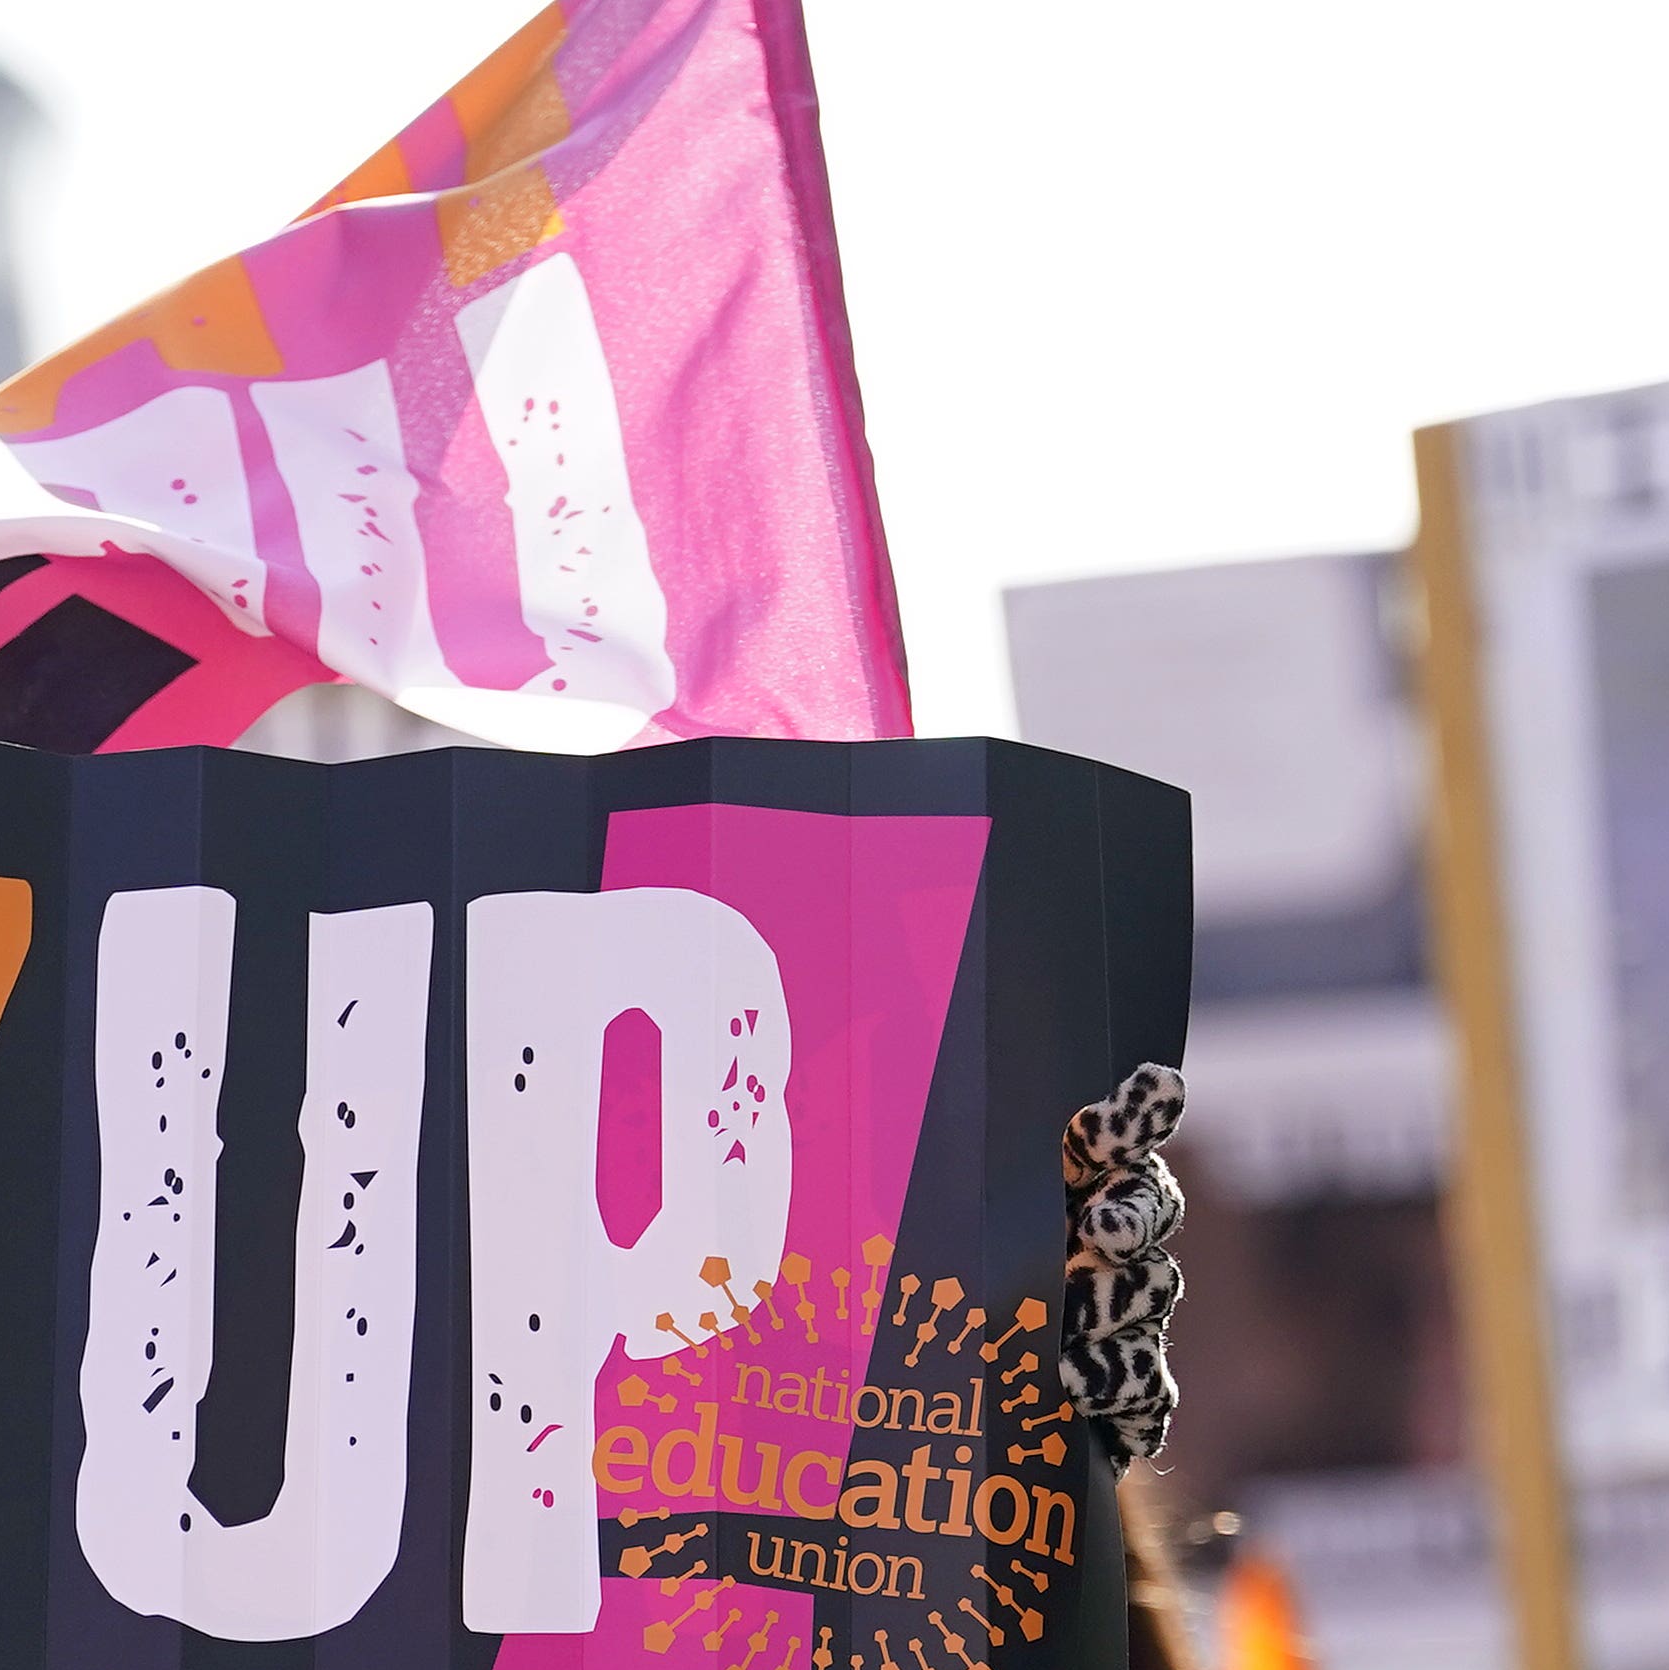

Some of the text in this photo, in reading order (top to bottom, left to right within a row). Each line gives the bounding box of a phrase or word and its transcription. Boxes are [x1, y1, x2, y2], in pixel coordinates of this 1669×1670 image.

[77, 886, 793, 1641] UP
[731, 1362, 985, 1437] national
[592, 1402, 1077, 1566] education
[746, 1530, 927, 1600] union
